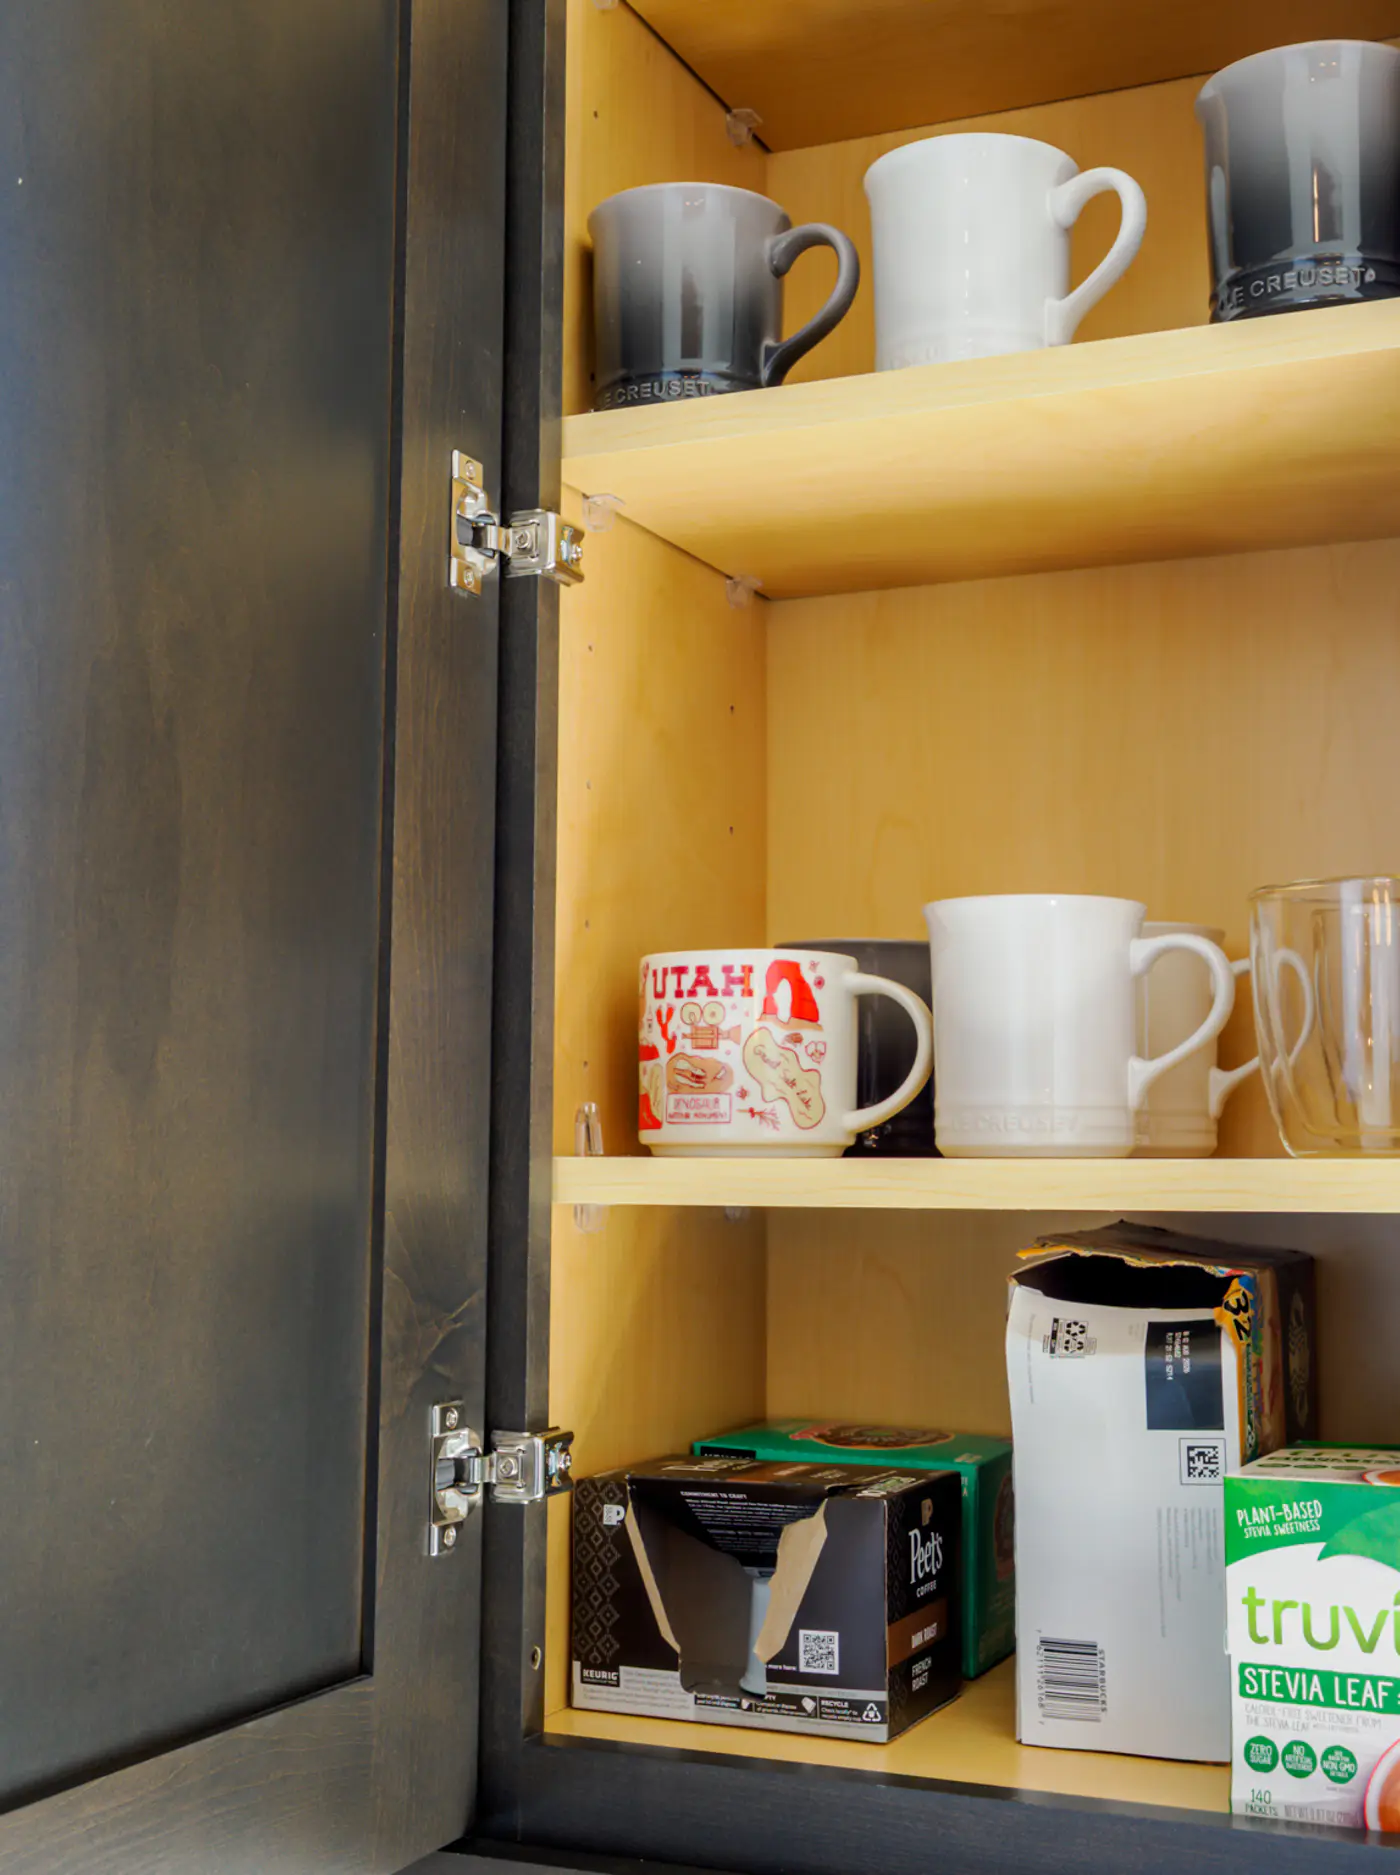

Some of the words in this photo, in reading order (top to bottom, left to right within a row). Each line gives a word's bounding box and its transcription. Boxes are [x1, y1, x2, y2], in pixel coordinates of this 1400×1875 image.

[1250, 267, 1365, 297] CREUSET
[616, 381, 709, 404] CREUSET
[652, 965, 754, 999] UTAH
[1223, 1293, 1252, 1341] 32
[1236, 1500, 1322, 1526] PLANT-BASED
[1244, 1525, 1271, 1538] STEVIA
[1274, 1519, 1320, 1536] SWEETNESS
[908, 1528, 943, 1584] Peet's
[916, 1580, 937, 1597] COFFEE
[583, 1669, 618, 1680] KEURIG
[911, 1657, 932, 1677] FRENCH
[911, 1671, 928, 1691] ROAST
[1098, 1649, 1107, 1713] STARBUCKS
[1244, 1668, 1324, 1702] STEVIA
[1334, 1676, 1393, 1708] LEAF
[821, 1700, 849, 1708] RECYCLE
[1250, 1743, 1272, 1755] ZERO
[1293, 1745, 1305, 1756] NO
[1323, 1760, 1338, 1770] NON
[1339, 1762, 1355, 1772] GMO
[1251, 1789, 1271, 1804] 140
[1245, 1803, 1278, 1816] PACKETS
